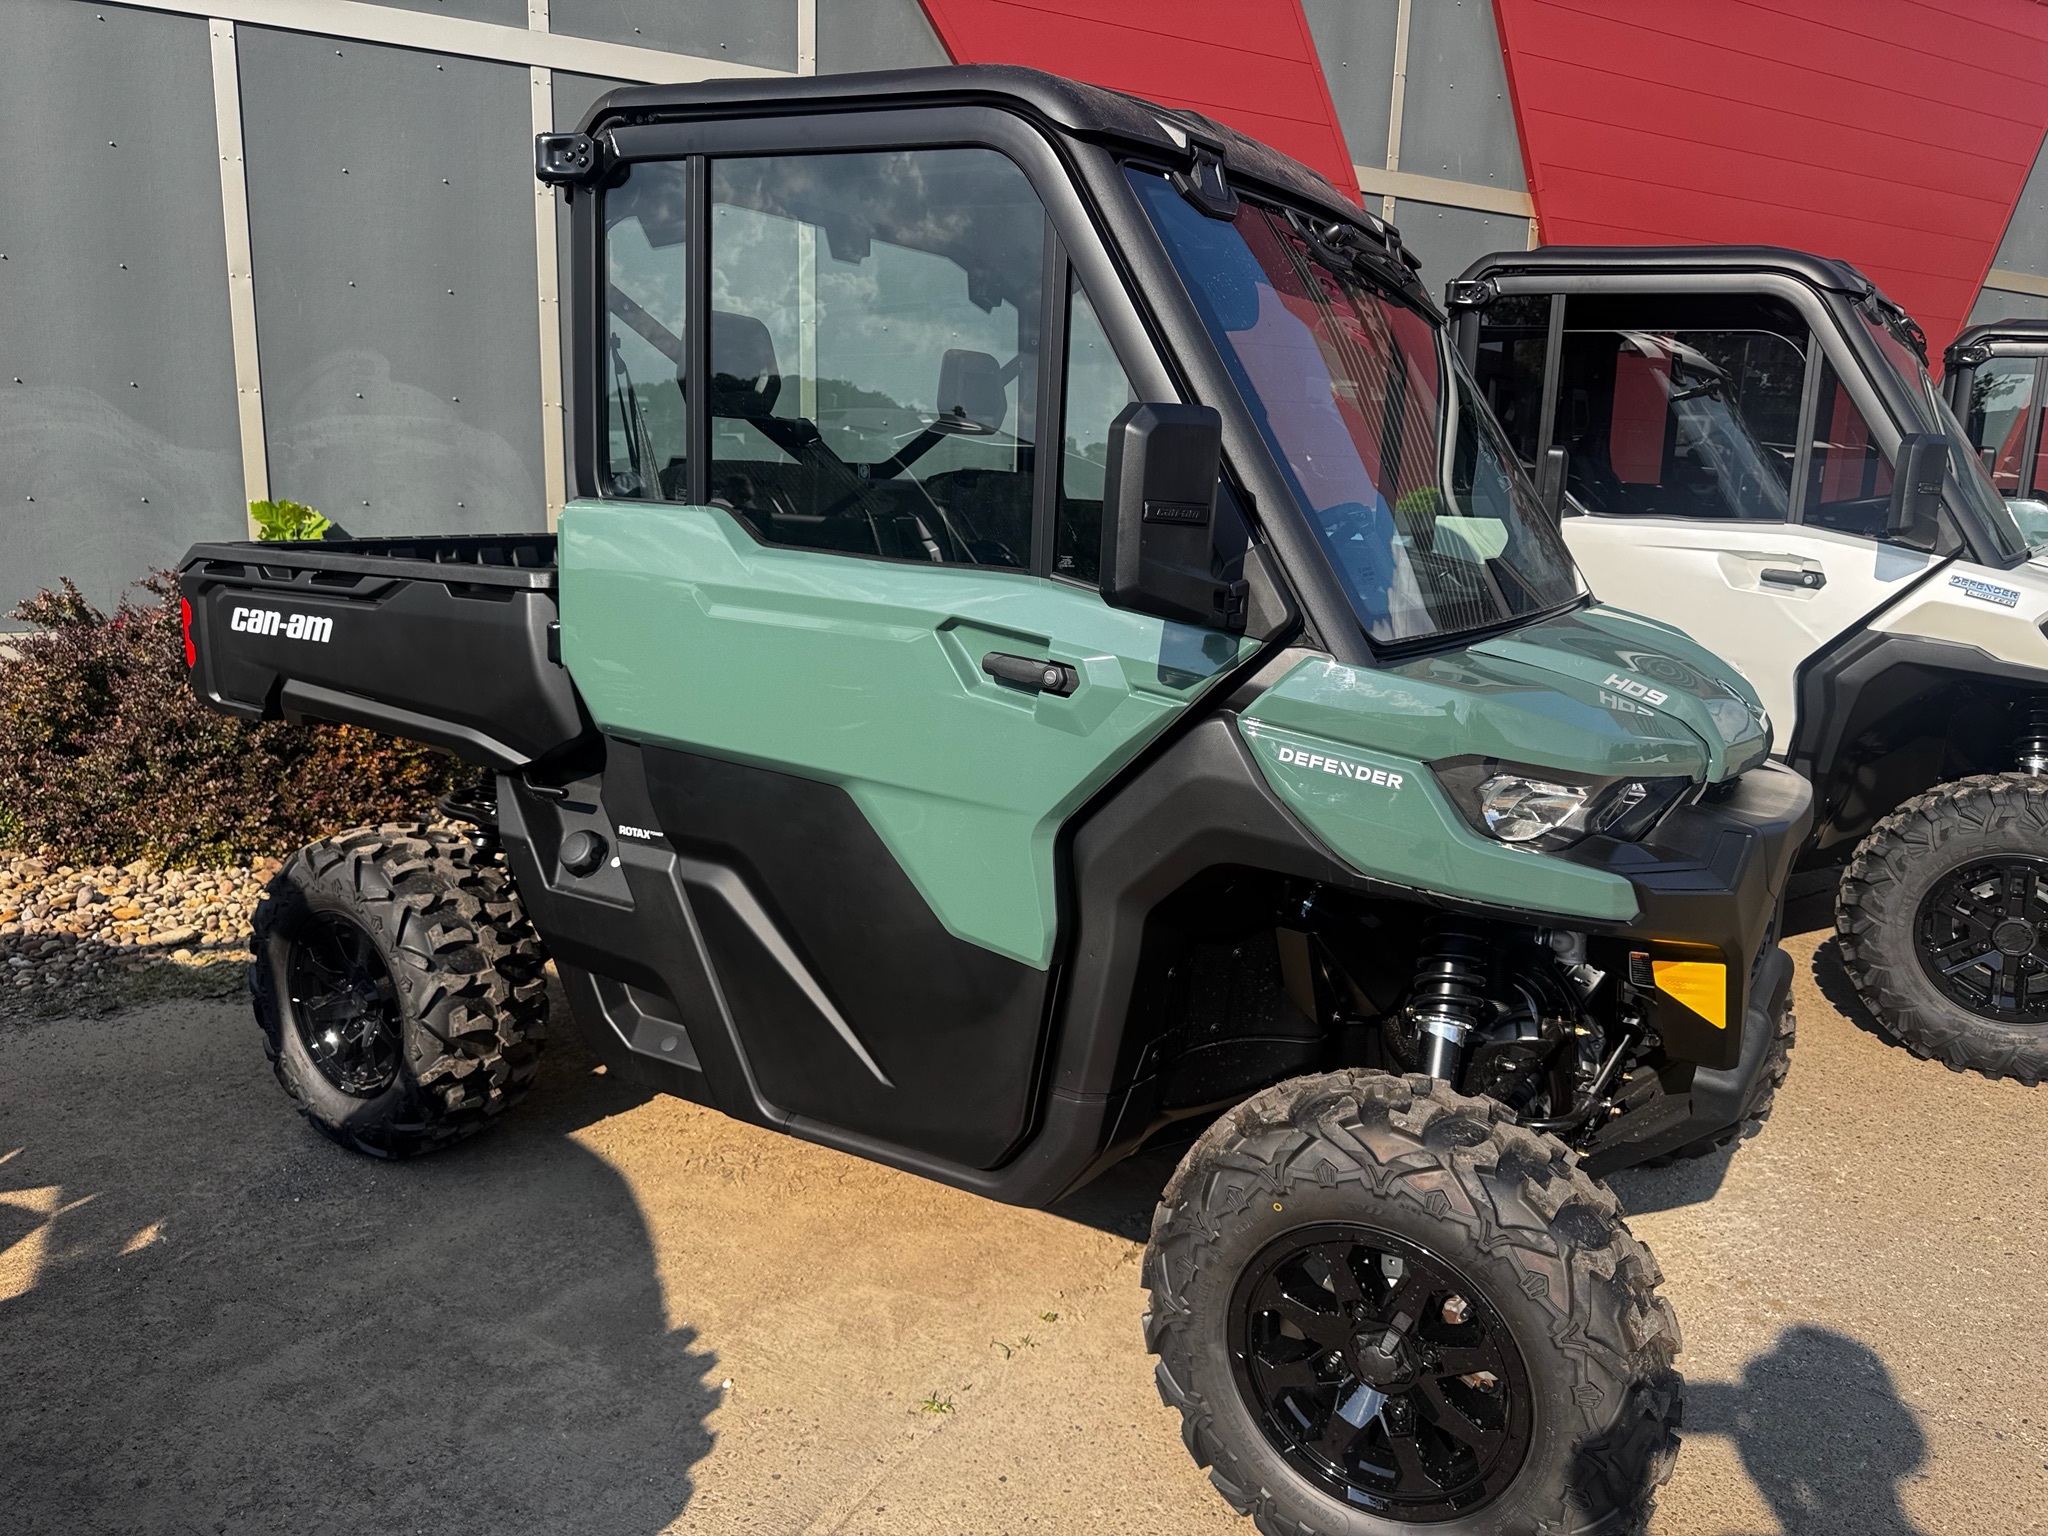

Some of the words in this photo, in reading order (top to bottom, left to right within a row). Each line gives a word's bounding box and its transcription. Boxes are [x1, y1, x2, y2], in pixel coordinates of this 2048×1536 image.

[1952, 576, 2018, 600] DEFENDER
[231, 607, 333, 643] can-am
[1603, 673, 1668, 706] HD9
[1278, 747, 1403, 790] DEFENDER
[618, 824, 651, 840] ROTAX
